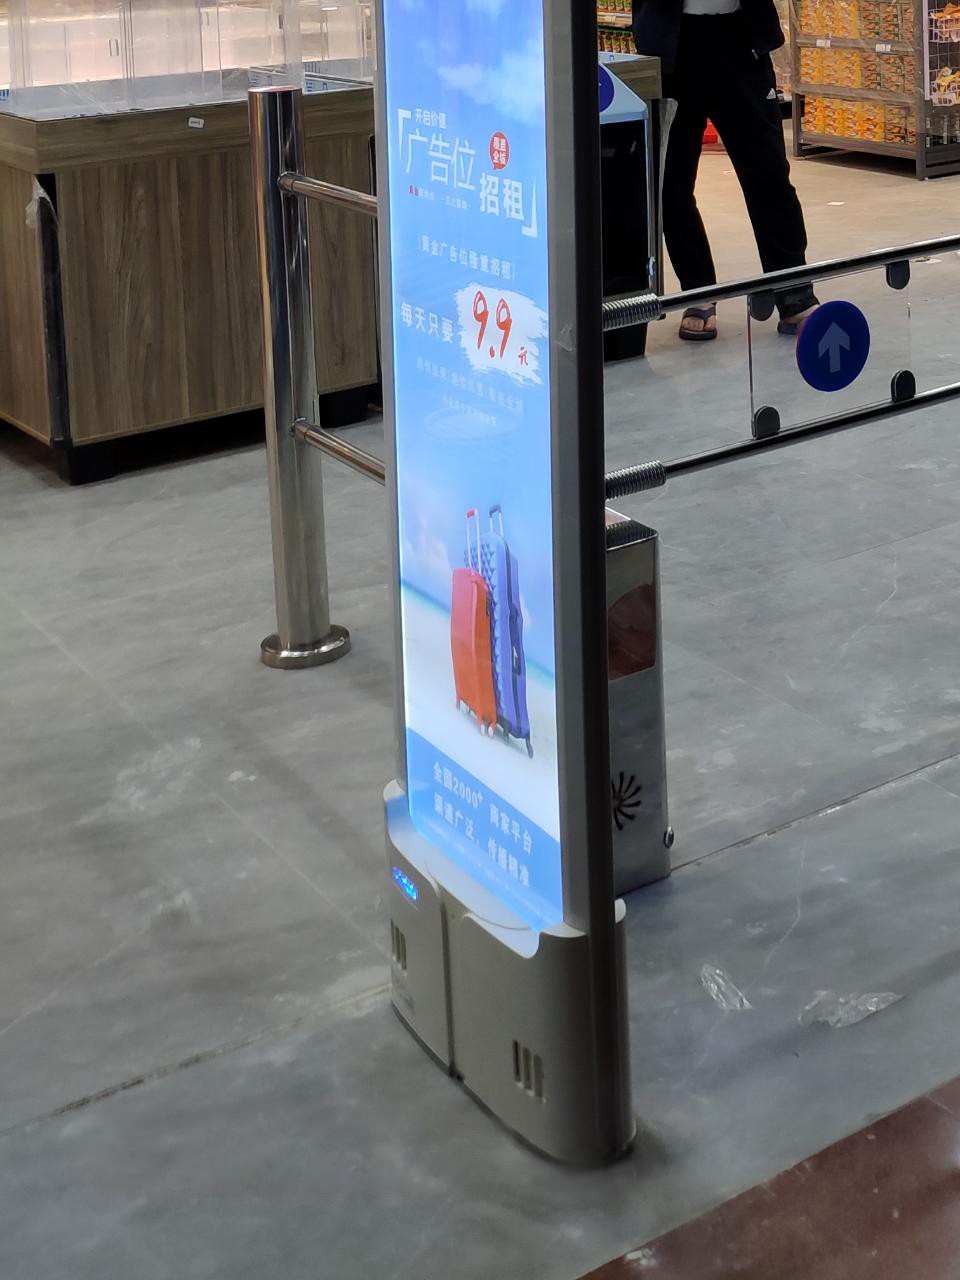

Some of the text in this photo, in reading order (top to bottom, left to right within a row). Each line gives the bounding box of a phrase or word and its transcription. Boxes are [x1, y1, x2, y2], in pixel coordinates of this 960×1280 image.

[414, 107, 447, 130] 开启价值
[406, 127, 476, 192] 广告位
[480, 173, 524, 221] 招租
[401, 303, 453, 345] 每天只要
[473, 291, 512, 358] 9.9
